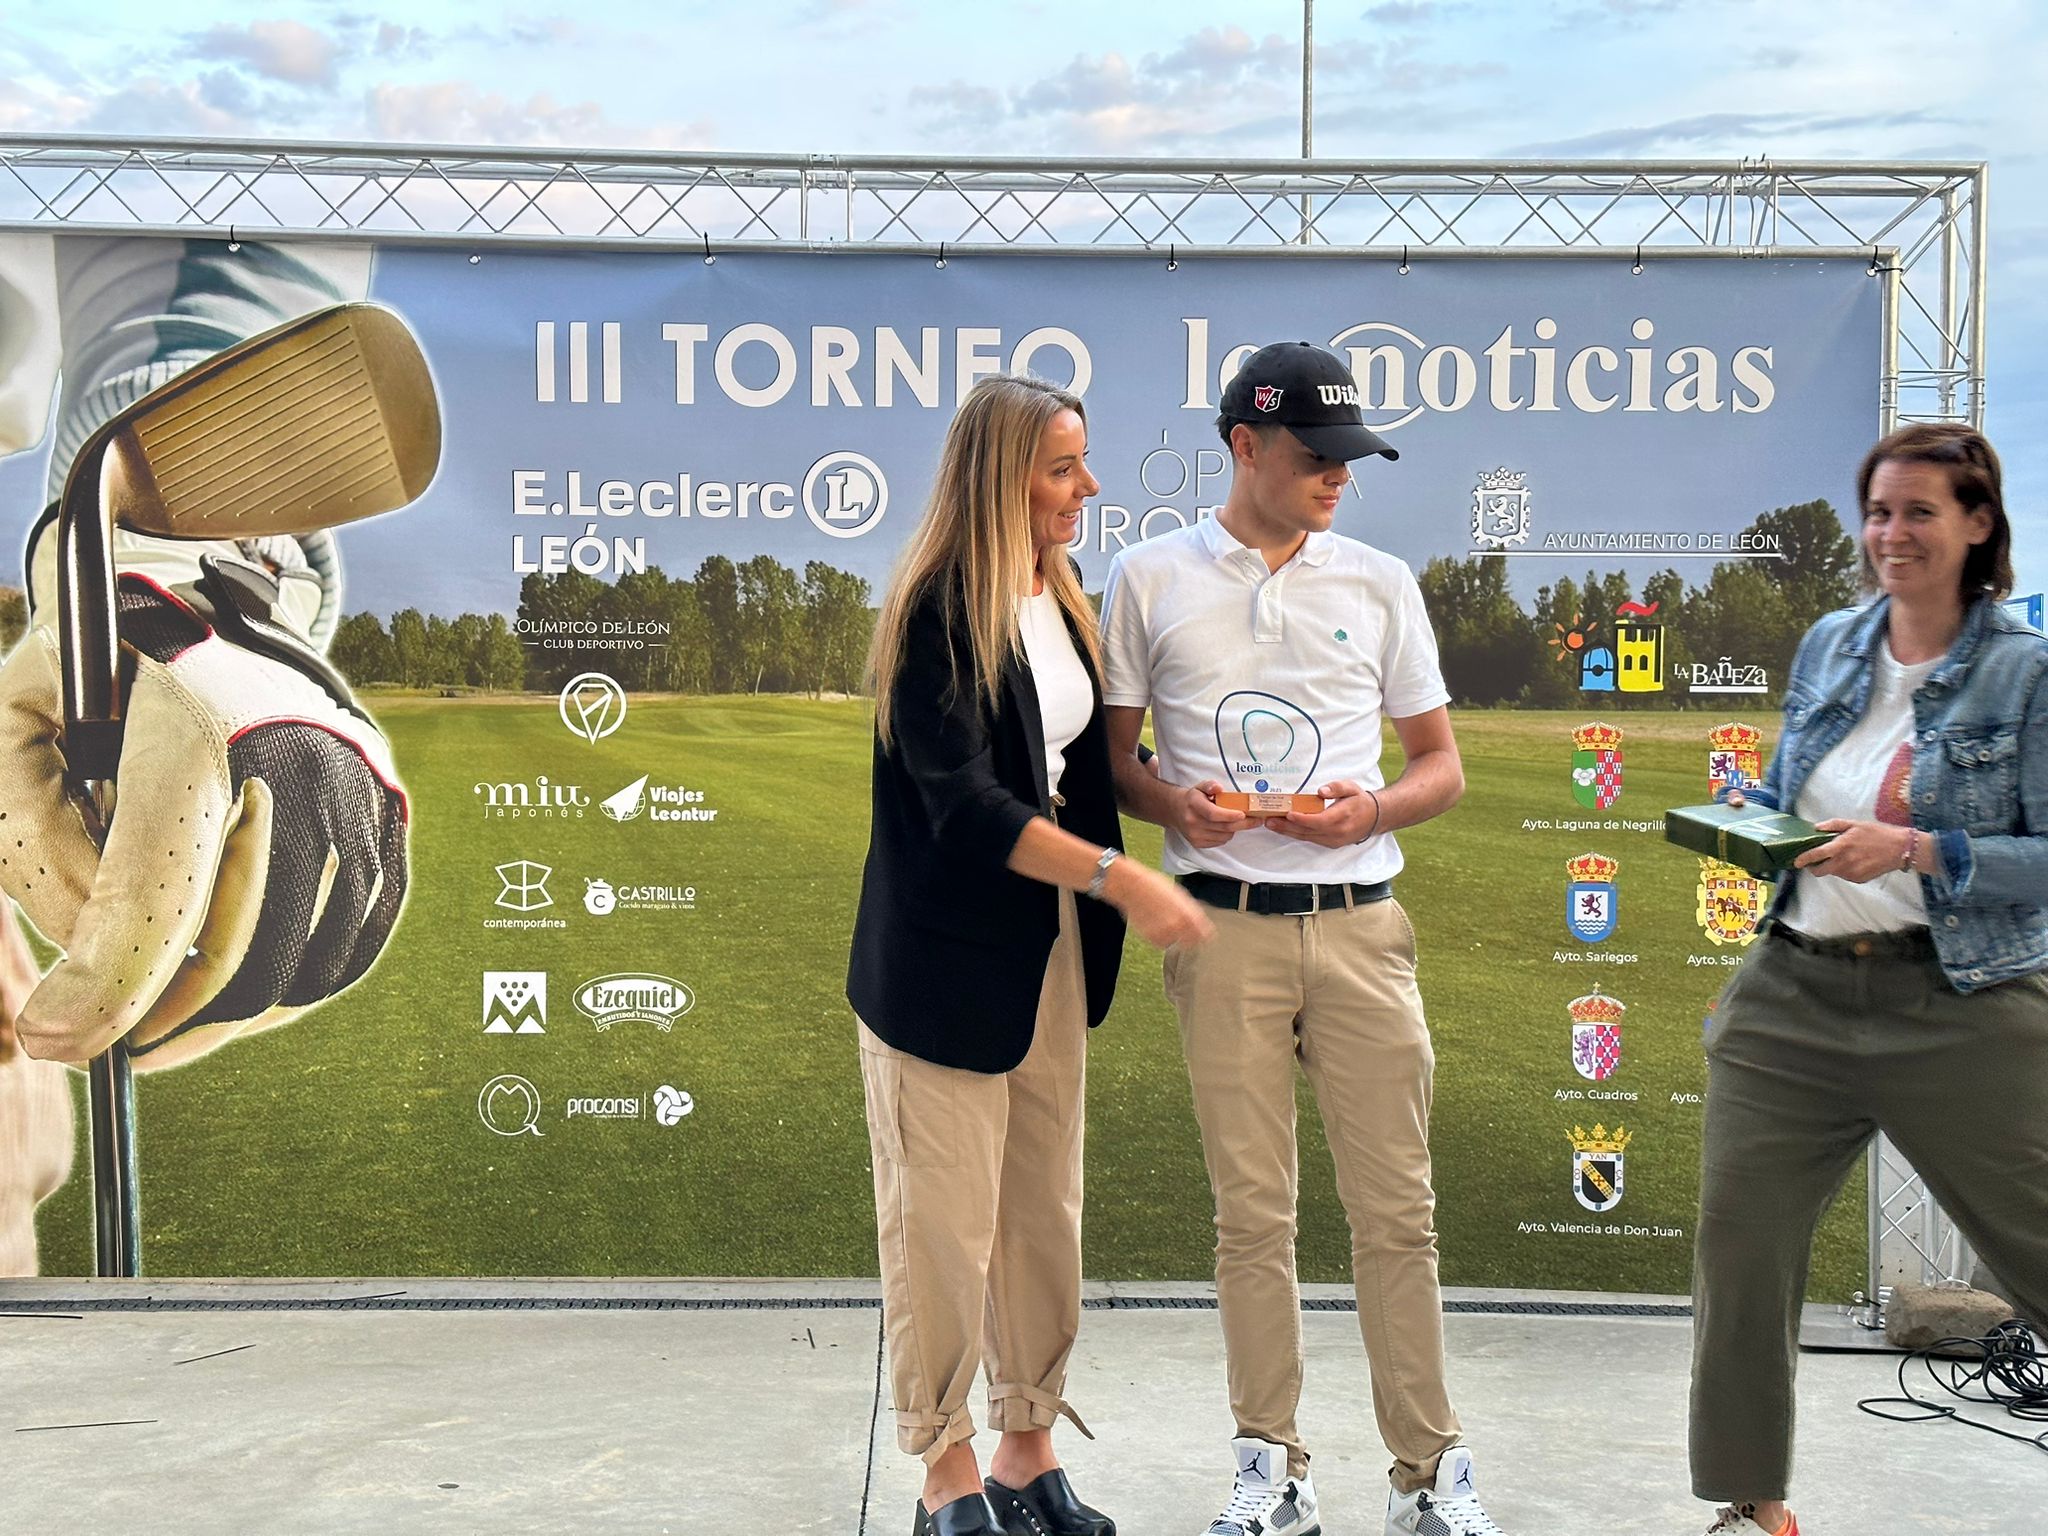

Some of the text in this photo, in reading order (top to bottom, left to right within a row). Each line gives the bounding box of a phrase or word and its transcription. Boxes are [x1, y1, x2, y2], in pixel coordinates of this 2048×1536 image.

[535, 321, 1093, 408] III TORNEO
[1180, 317, 1775, 414] lnoticias
[512, 470, 795, 519] E.Leclerc
[1544, 530, 1779, 549] AYUNTAMIENTO DE LEÓN
[512, 523, 646, 576] LEÓN
[517, 618, 671, 636] OLÍMPICO DE LEÓN
[543, 639, 644, 650] CLUB DEPORTIVO
[473, 775, 590, 807] miu
[650, 786, 704, 803] Viajes
[484, 805, 584, 819] japonés
[650, 806, 718, 822] Leontur
[1521, 818, 1667, 833] Ayto. Laguna de Negrill
[618, 886, 696, 901] CASTRILLO
[483, 917, 566, 930] contemporánea
[1552, 951, 1638, 964] Ayto. Sariegos
[1686, 954, 1718, 967] Ayto.
[592, 985, 677, 1012] Ezequiel
[1554, 1088, 1638, 1101] Ayto. Cuadros
[1670, 1092, 1702, 1105] Ayto.
[567, 1098, 639, 1119] proconsi
[1517, 1221, 1683, 1237] Ayto. Valencia de Don Juan
